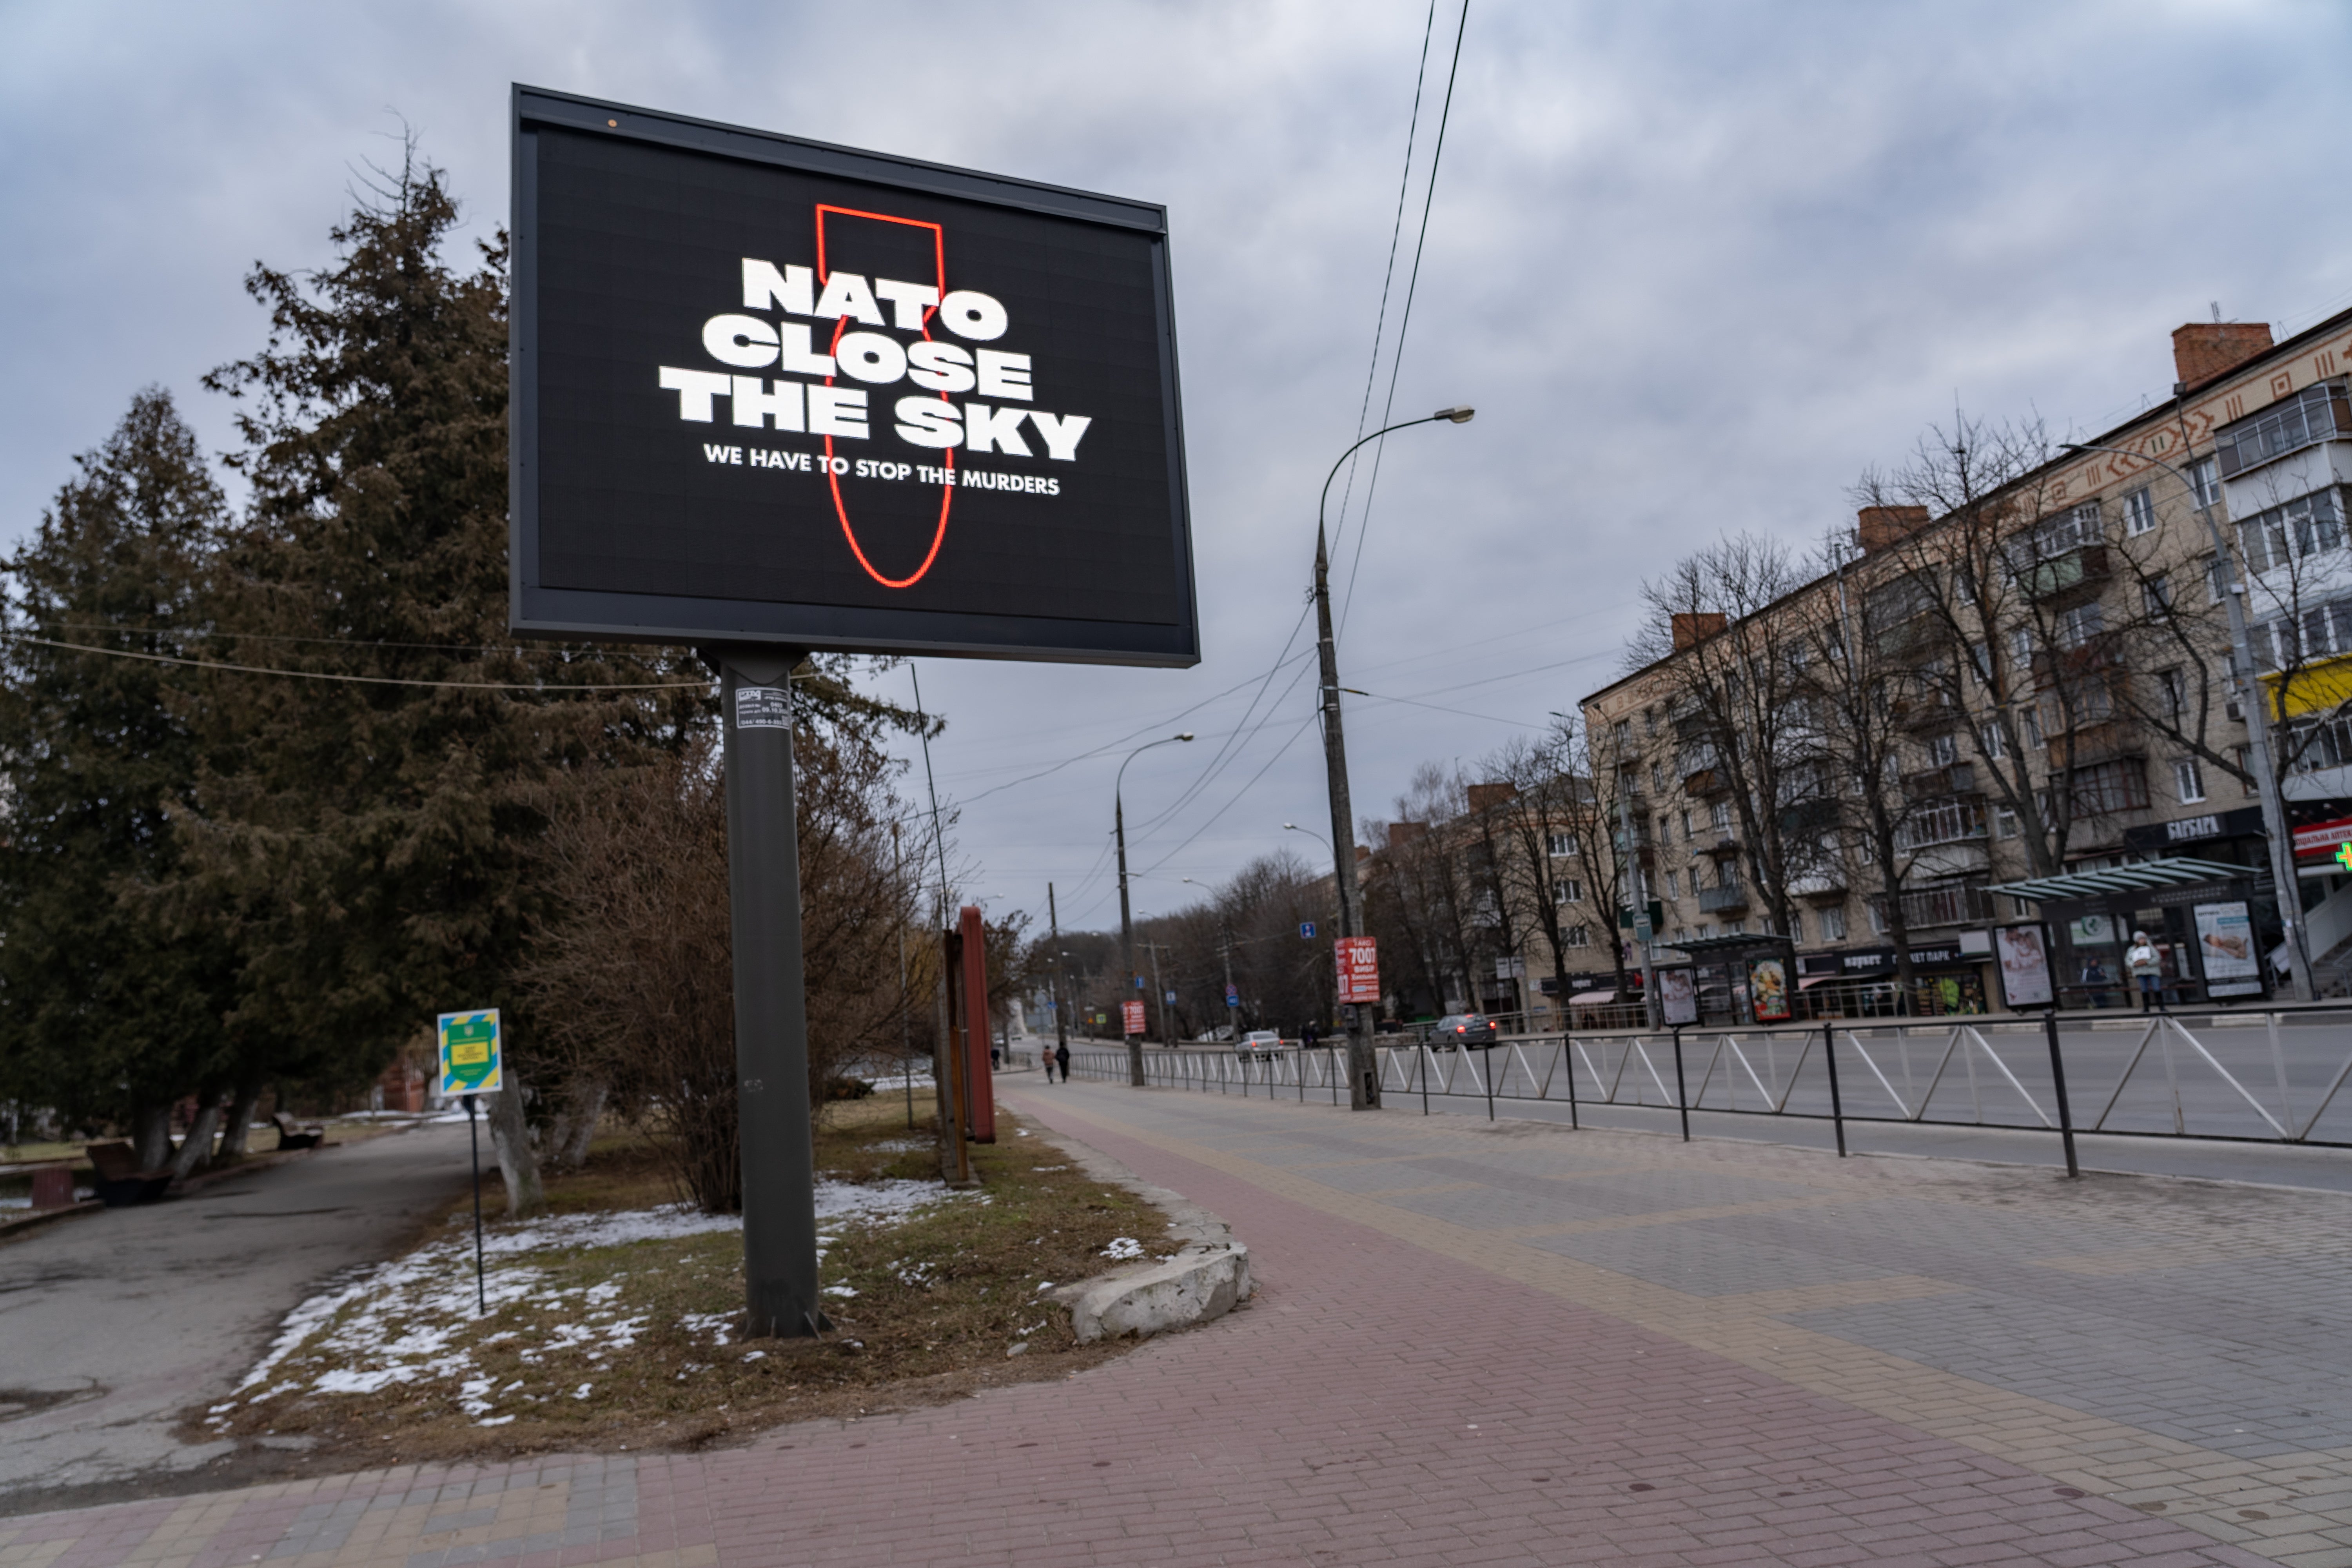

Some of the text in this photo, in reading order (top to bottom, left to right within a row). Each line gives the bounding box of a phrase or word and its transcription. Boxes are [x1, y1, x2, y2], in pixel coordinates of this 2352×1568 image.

[742, 257, 1009, 341] NATO
[702, 314, 1034, 402] CLOSE
[658, 365, 1093, 462] THE SKY
[703, 443, 1059, 495] WE HAVE TO STOP THE MURDERS
[2167, 815, 2220, 840] БАРБАРА
